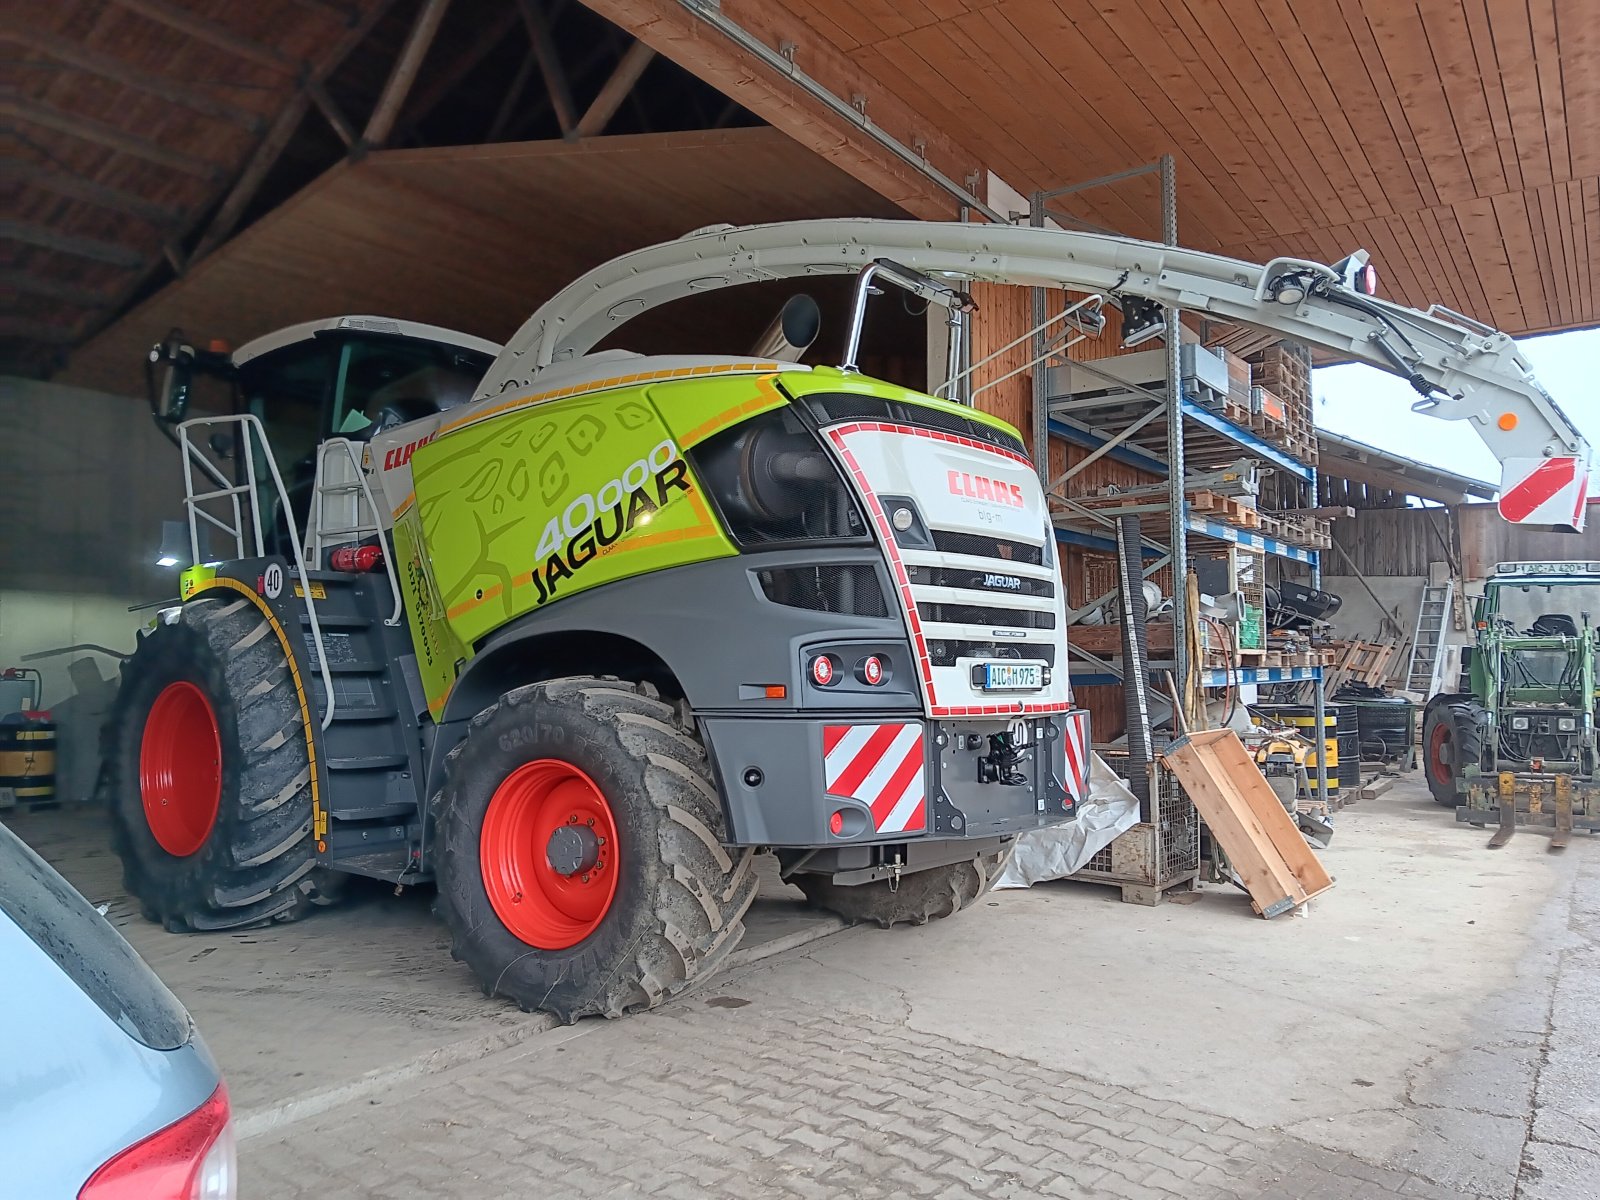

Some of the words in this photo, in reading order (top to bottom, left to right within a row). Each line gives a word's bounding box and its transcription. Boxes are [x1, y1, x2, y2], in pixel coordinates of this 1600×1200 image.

[535, 438, 677, 562] 40000
[947, 470, 1024, 508] CLAAS
[532, 459, 691, 605] JAGUAR
[267, 570, 279, 592] 40
[983, 573, 1021, 589] JAGUAR
[991, 667, 1006, 686] AIC
[1019, 667, 1035, 686] 975
